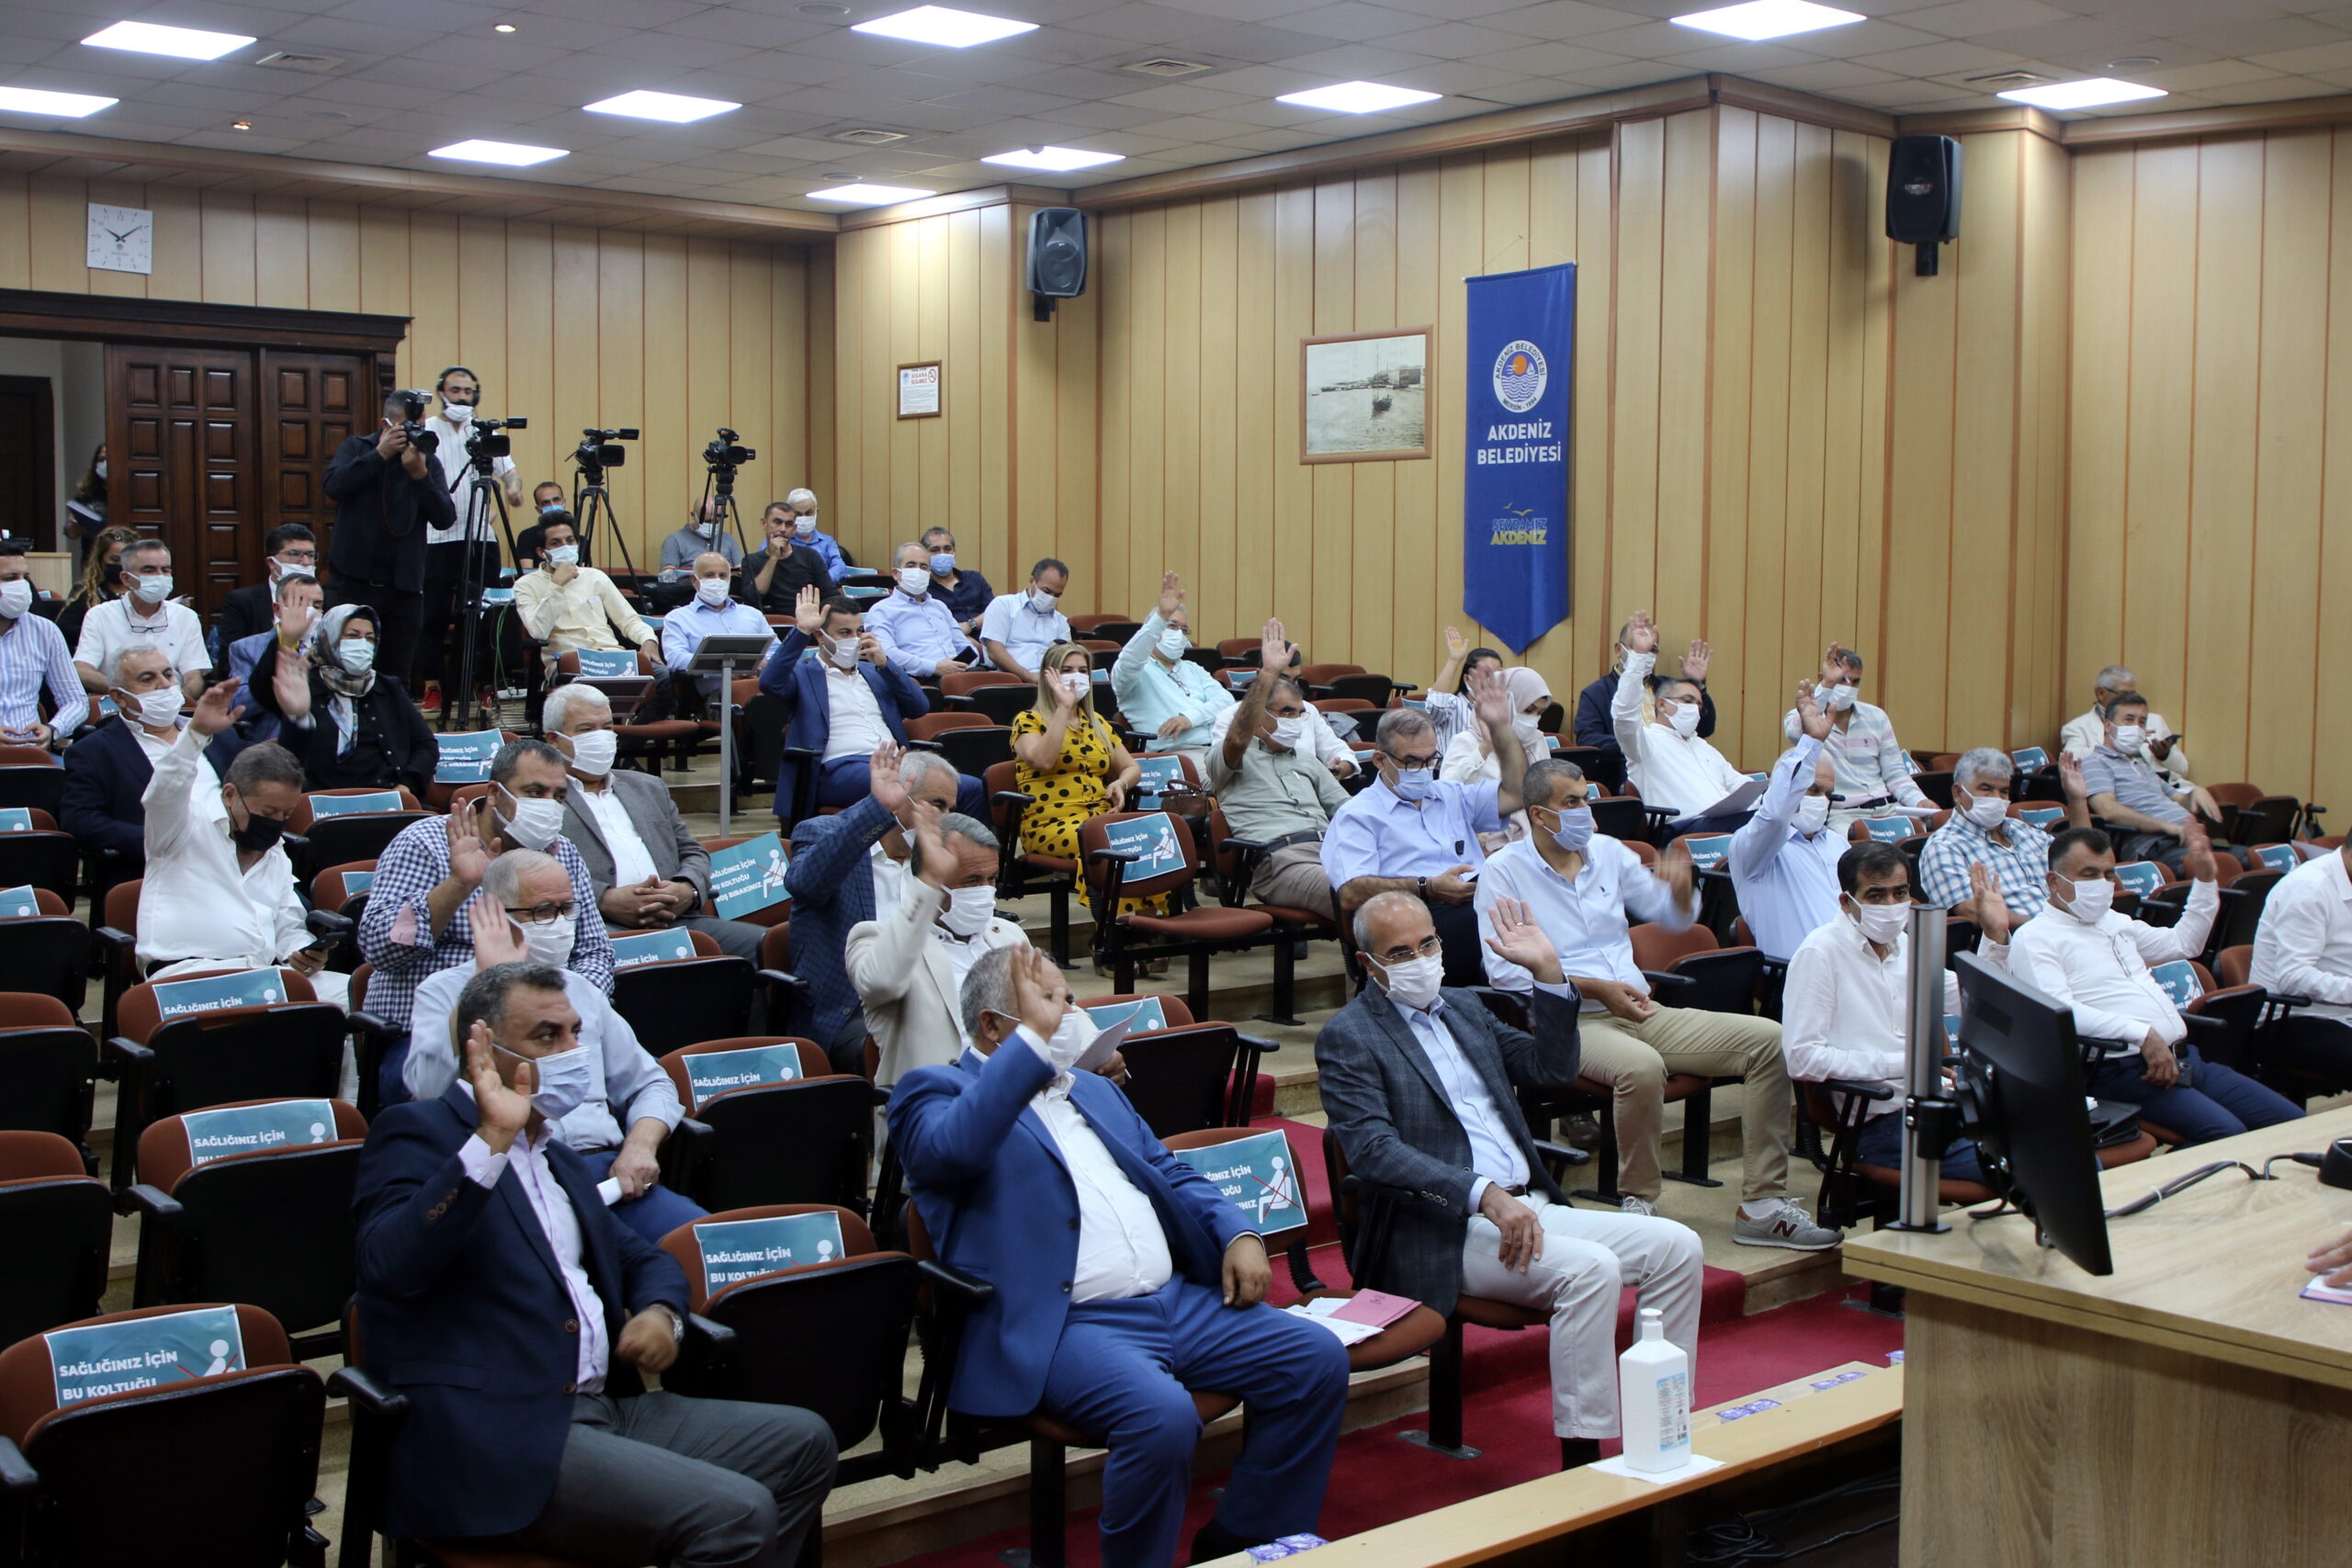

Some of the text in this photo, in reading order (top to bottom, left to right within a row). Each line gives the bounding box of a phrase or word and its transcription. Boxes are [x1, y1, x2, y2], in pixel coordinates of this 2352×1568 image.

[1495, 343, 1547, 379] AKDENİZ BELEDİYESİ
[1487, 418, 1552, 441] AKDENİZ
[1477, 441, 1561, 465] BELEDİYESİ
[740, 858, 756, 869] İÇİN
[721, 874, 751, 890] KOLTUĞU
[729, 881, 763, 899] BIRAKINIZ
[639, 953, 660, 964] İÇİN
[164, 996, 243, 1015] SAĞLIĞINIZ İÇİN
[693, 1072, 761, 1088] SAĞLIĞINIZ İÇİN
[194, 1129, 286, 1148] SAĞLIĞINIZ İÇİN
[1230, 1164, 1252, 1179] İÇİN
[1771, 1220, 1798, 1237] N
[706, 1246, 792, 1265] SAĞLIĞINIZ İÇİN
[710, 1269, 776, 1283] BU KOLTUĞ
[59, 1349, 179, 1378] SAĞLIĞINIZ İÇİN
[62, 1377, 157, 1401] BU KOLTUĞU
